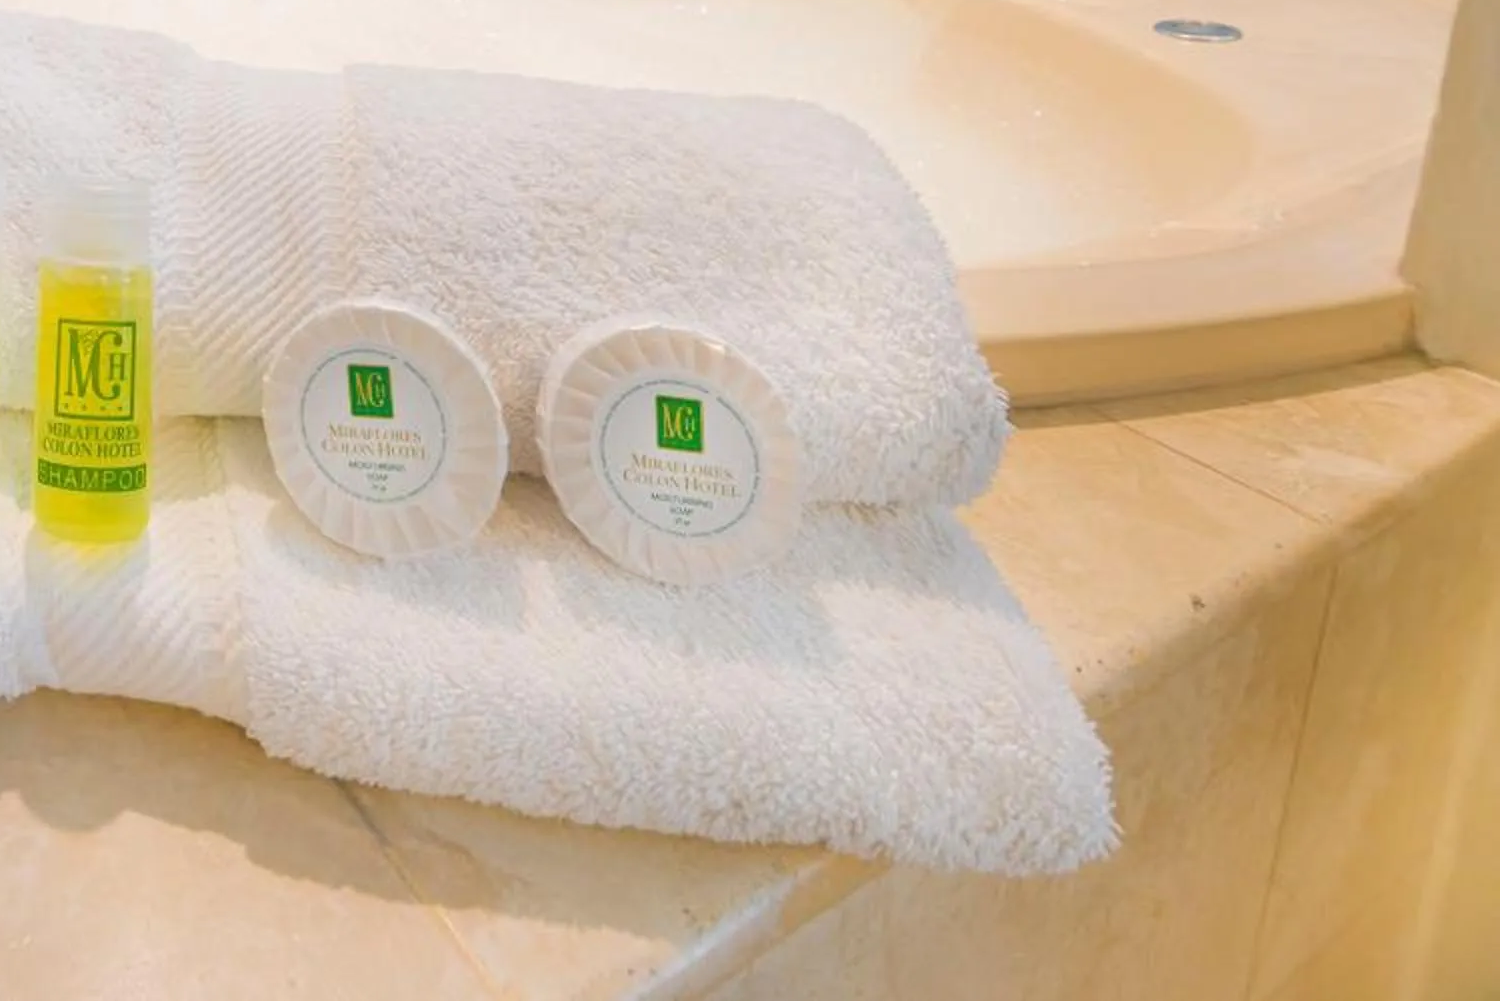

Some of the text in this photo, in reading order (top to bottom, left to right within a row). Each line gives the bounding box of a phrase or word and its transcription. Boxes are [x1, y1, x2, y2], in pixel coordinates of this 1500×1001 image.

[46, 422, 140, 441] MIRAFLORES
[328, 423, 422, 443] MIRAFLORES
[43, 438, 142, 458] COLON HOTEL
[321, 439, 426, 461] COLON HOTEL
[39, 462, 146, 490] SHAMPOO
[632, 453, 734, 479] MIRAFLORES
[623, 469, 741, 498] COLON HOTEL
